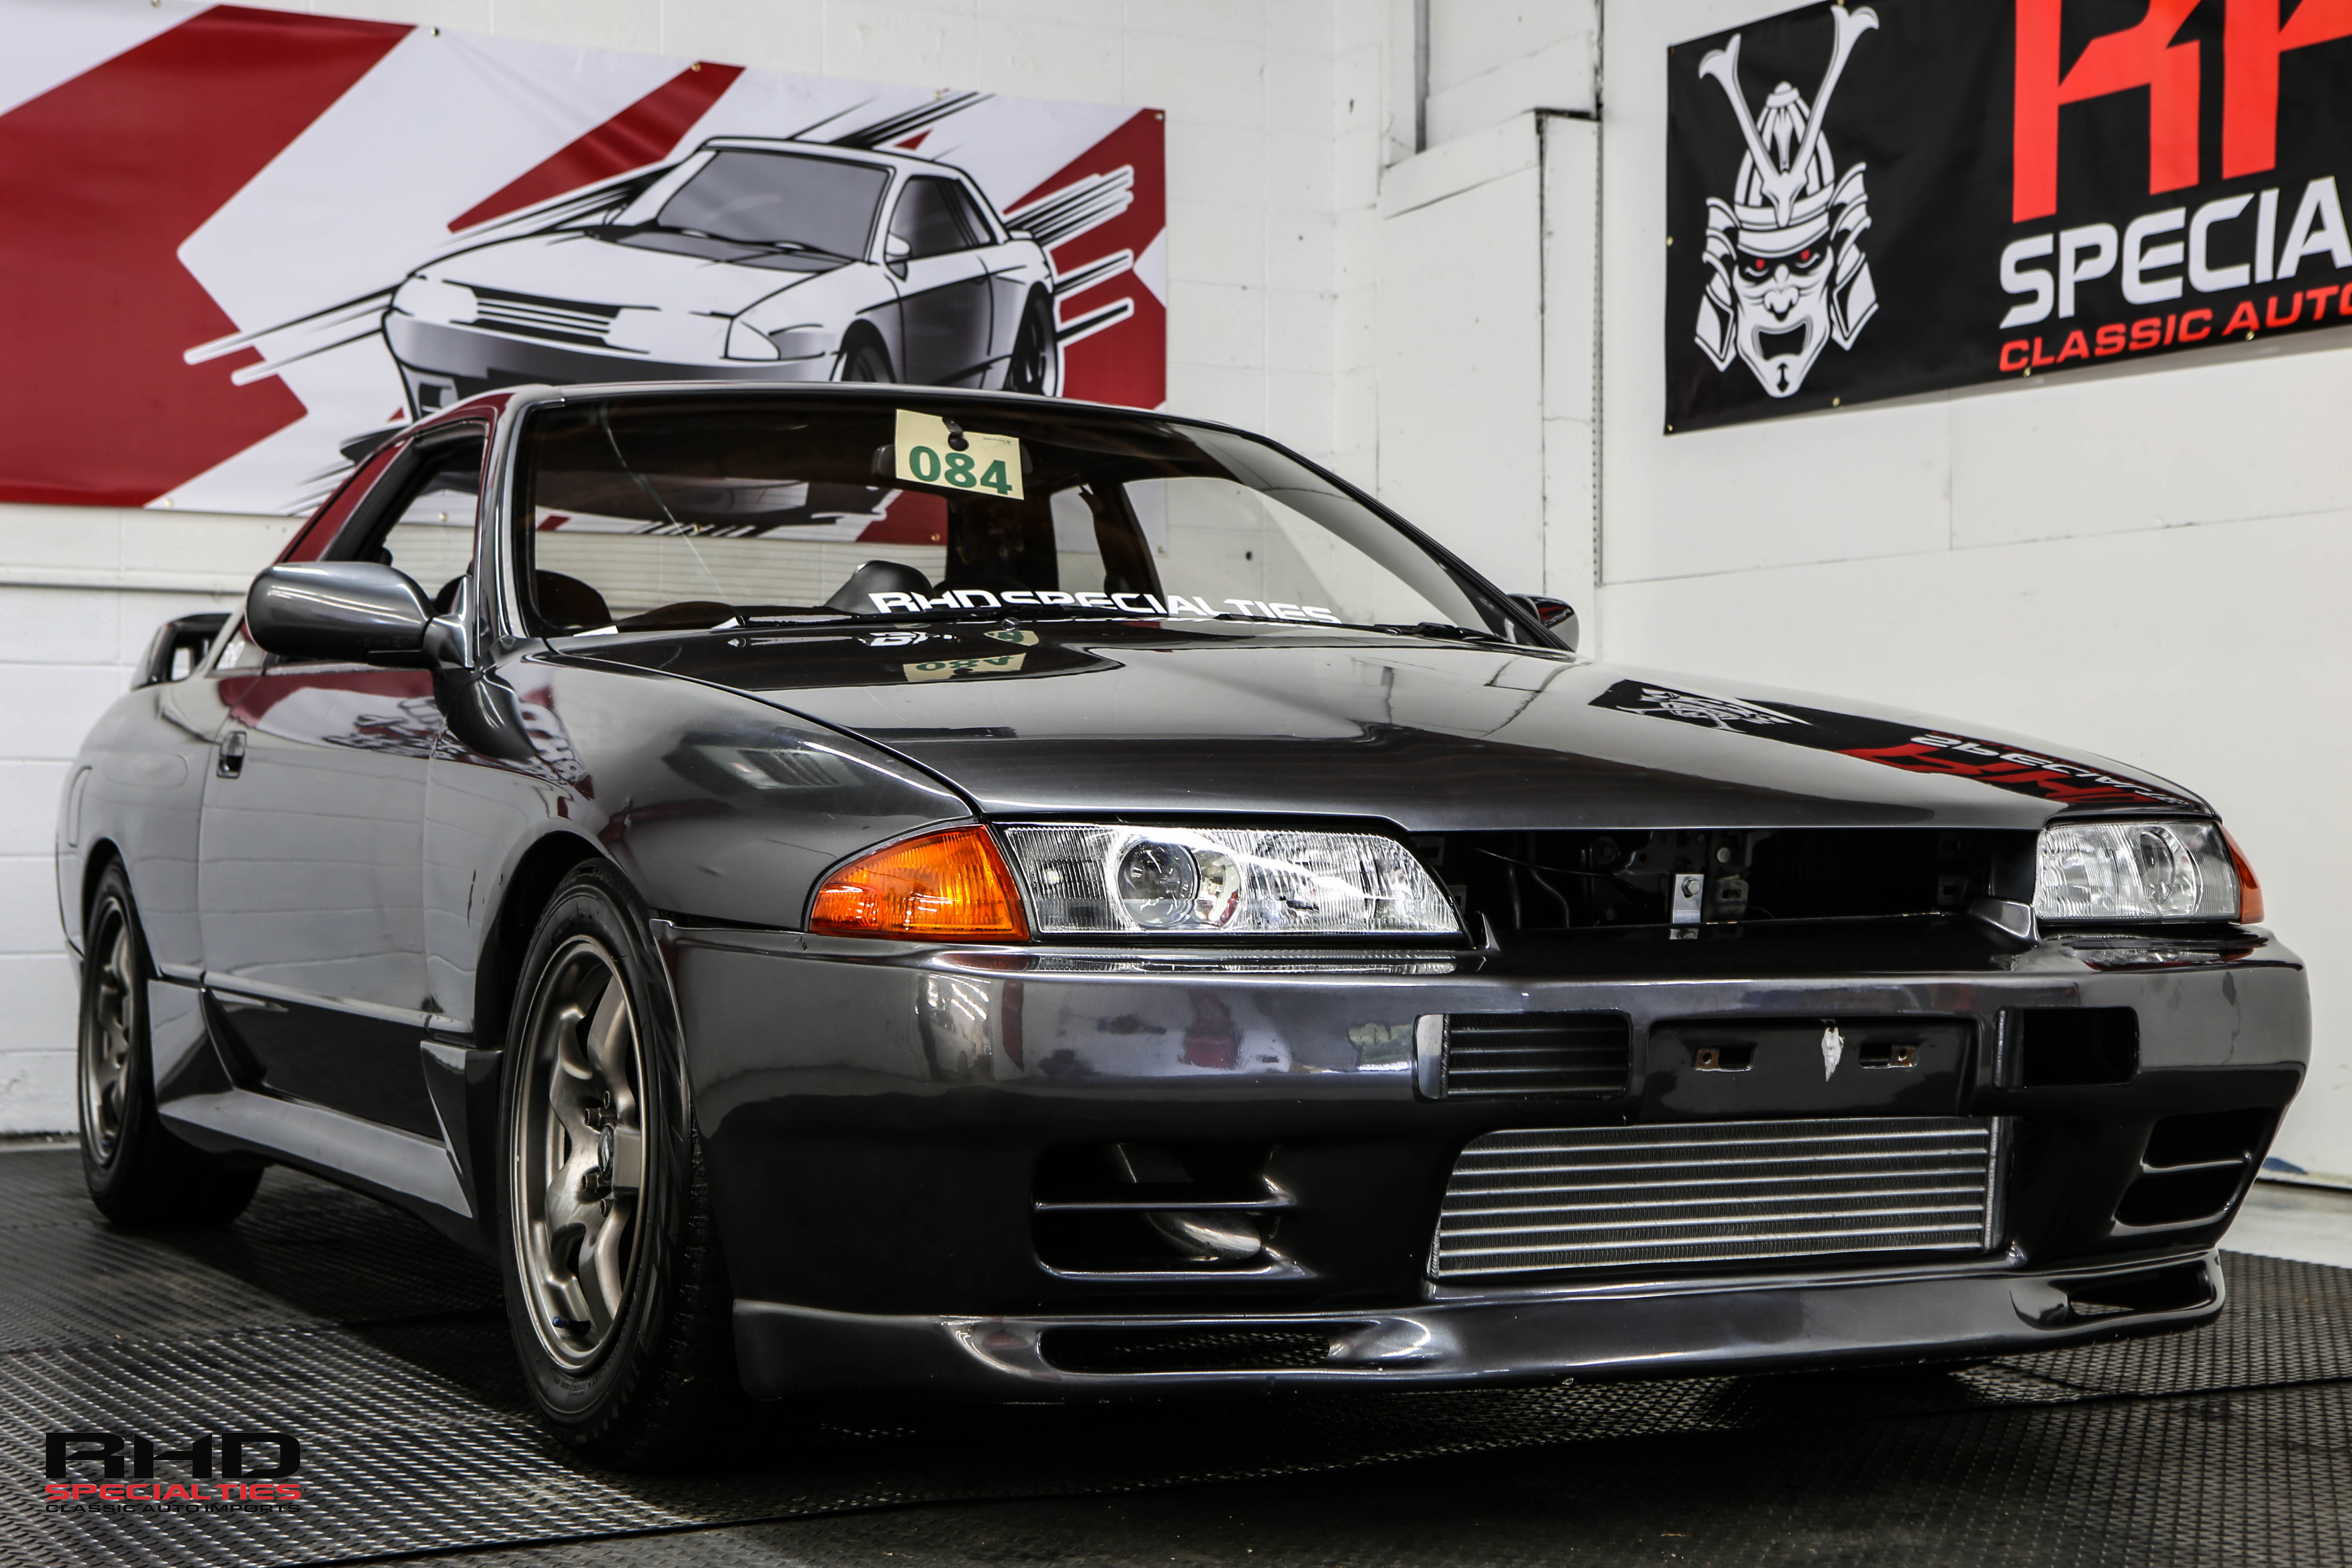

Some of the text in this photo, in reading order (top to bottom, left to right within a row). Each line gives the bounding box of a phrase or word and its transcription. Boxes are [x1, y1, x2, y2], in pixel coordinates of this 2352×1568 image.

[2000, 176, 2352, 329] SPECIA
[2000, 309, 2213, 371] CLASSIC
[909, 445, 1012, 496] 084
